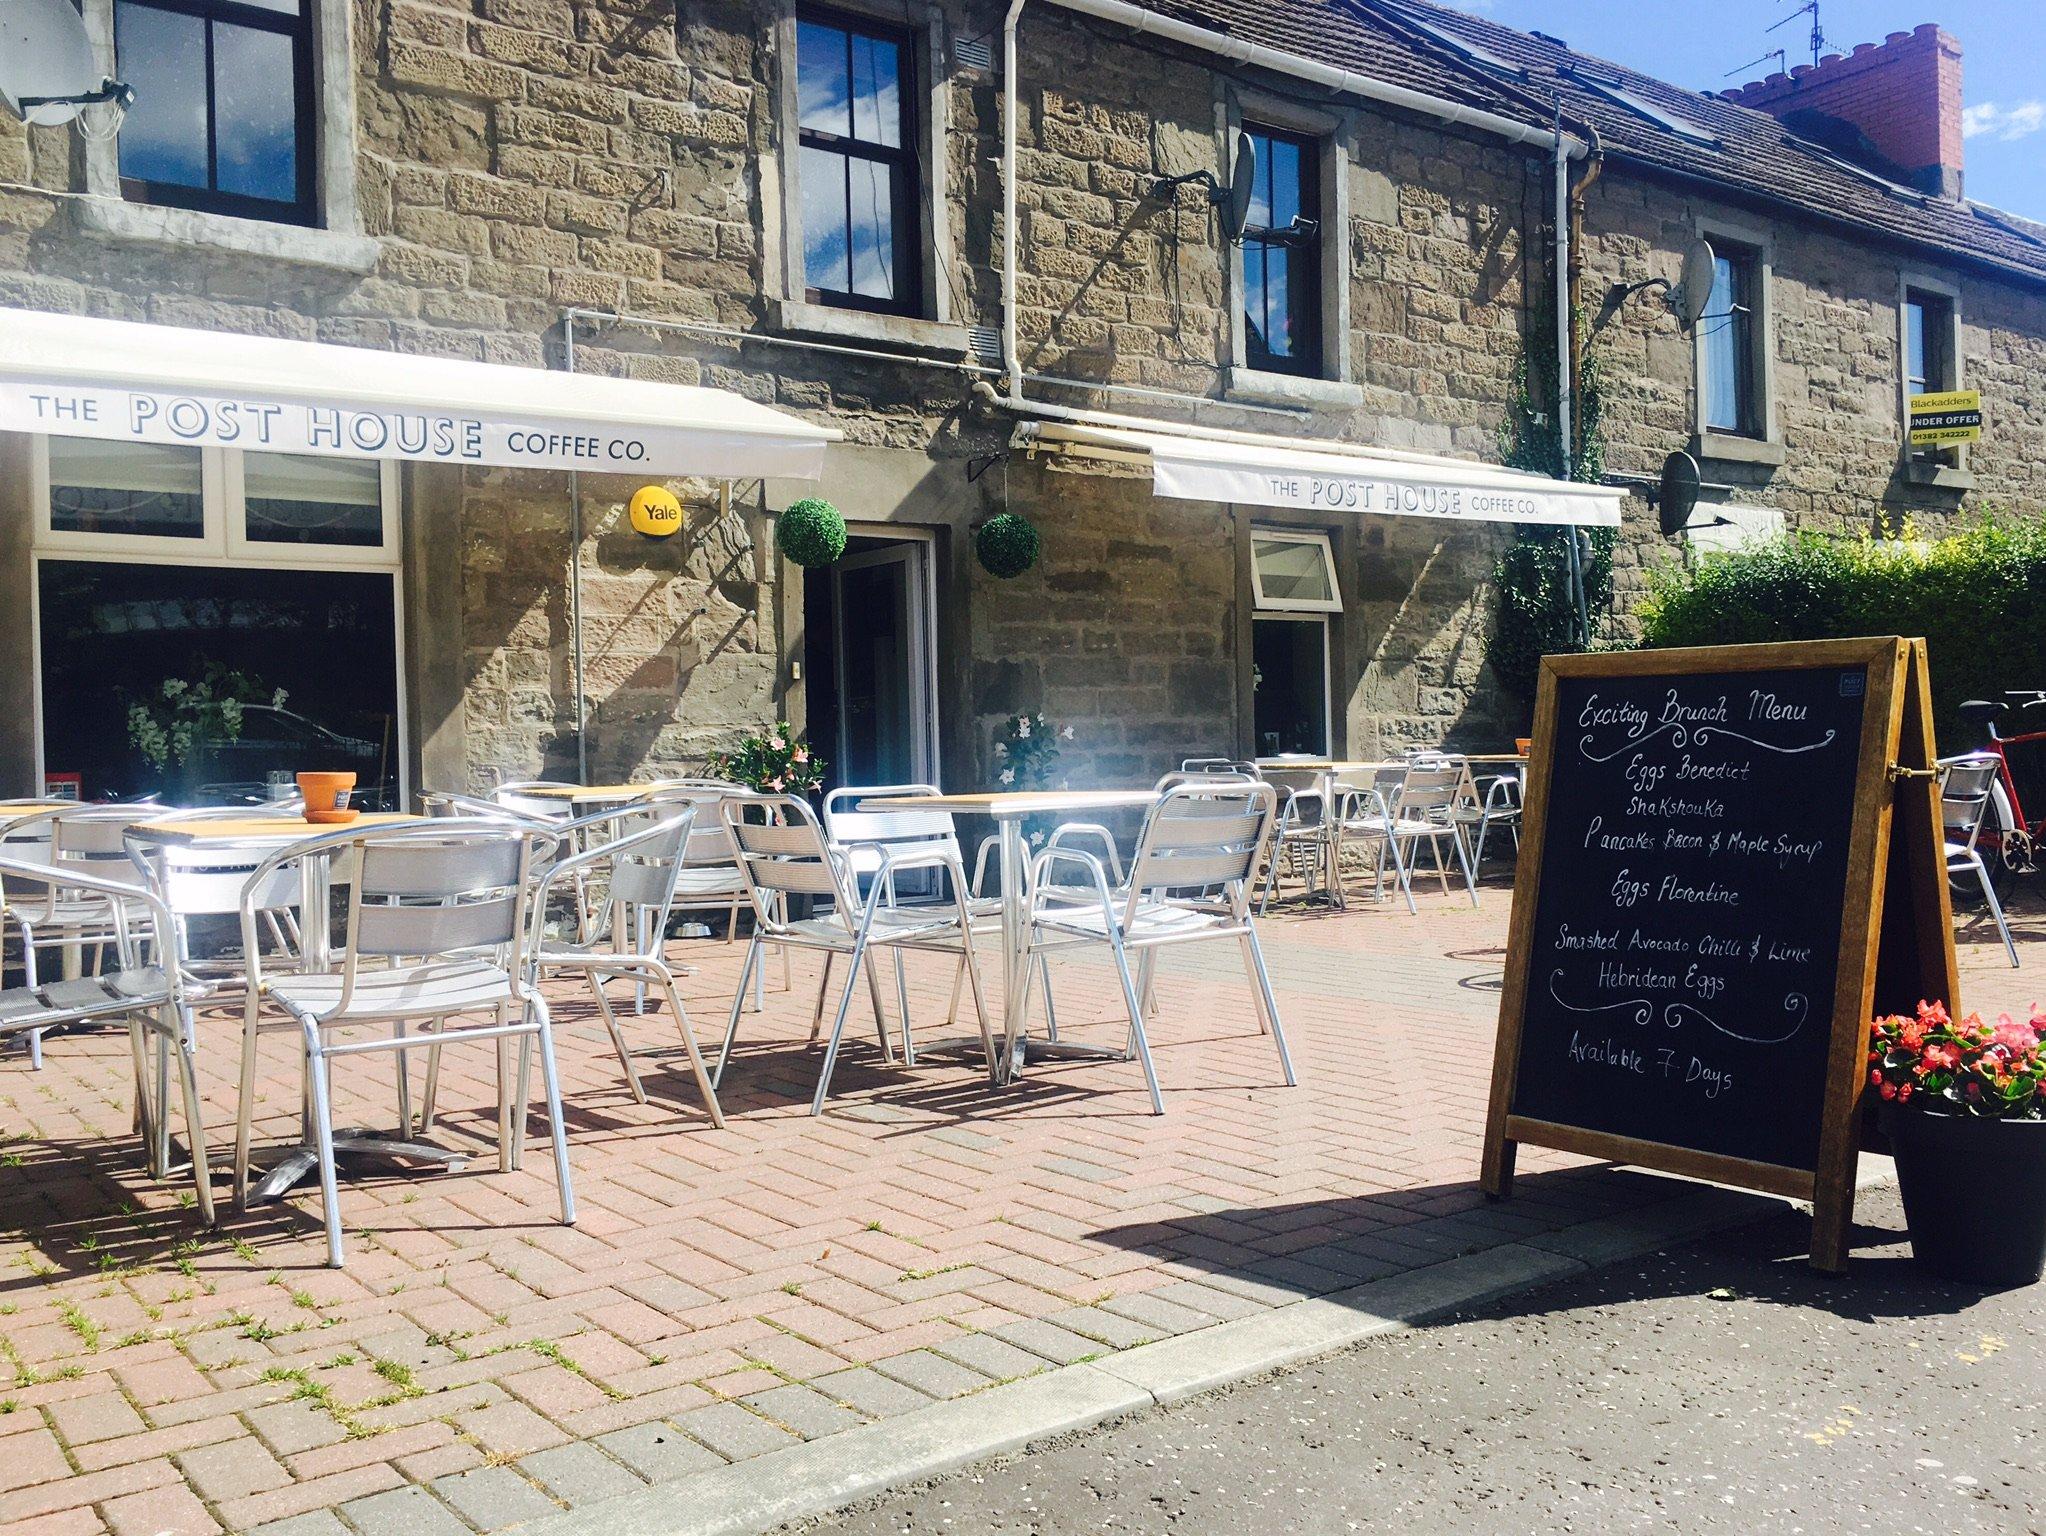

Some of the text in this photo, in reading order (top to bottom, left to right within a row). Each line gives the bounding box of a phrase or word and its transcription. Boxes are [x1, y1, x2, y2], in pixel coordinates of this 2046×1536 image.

[1911, 398, 1972, 408] Blackadders
[1946, 414, 1979, 425] OFFER
[29, 393, 651, 462] THE POST HOUSE COFFEE CO.
[1913, 430, 1970, 440] 01382 342222
[643, 504, 678, 521] Yale
[1271, 478, 1539, 514] THE POST HOUSE COFFEE CO.
[1579, 688, 1808, 738] Exciting Brunch Menu
[1625, 753, 1751, 792] Eggs Benedict
[1663, 828, 1704, 850] Bacon
[1727, 830, 1769, 856] Maple
[1773, 833, 1823, 870] Syrup
[1611, 868, 1740, 908] Eggs Florentine
[1555, 923, 1620, 950] Smashed
[1627, 928, 1690, 952] Avocado
[1698, 934, 1742, 957] Chilli
[1768, 941, 1812, 963] Lime
[1598, 961, 1726, 1000] Hebridean Eggs
[1568, 1030, 1733, 1099] Available 7 Days
